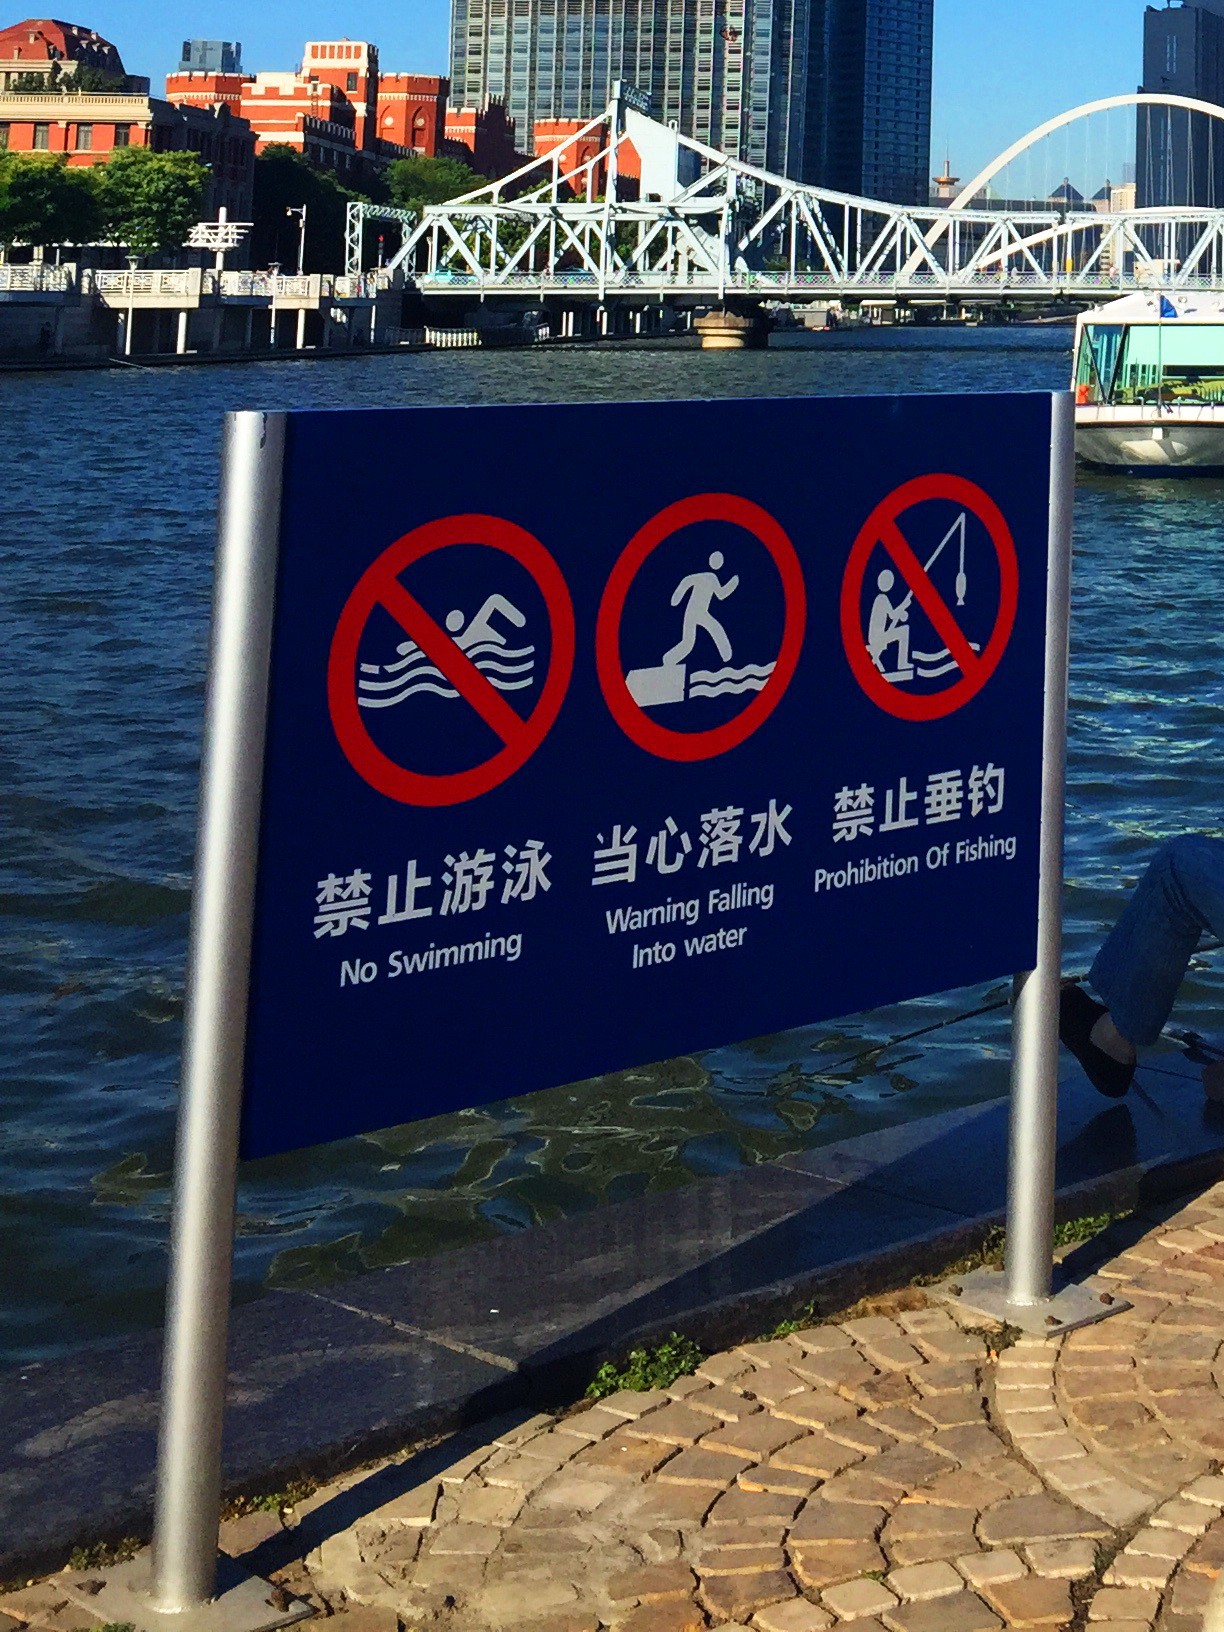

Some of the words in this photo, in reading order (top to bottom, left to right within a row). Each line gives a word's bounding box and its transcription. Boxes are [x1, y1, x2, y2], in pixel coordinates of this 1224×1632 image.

[832, 762, 1005, 843] 禁止垂钓
[591, 798, 793, 886] 当心落水
[814, 853, 919, 893] Prohibition
[925, 842, 950, 870] Of
[955, 834, 1017, 864] Fishing
[313, 839, 553, 939] 禁止游泳
[605, 897, 700, 934] Warning
[708, 882, 774, 914] Falling
[340, 958, 378, 987] No
[388, 932, 522, 978] Swimming
[632, 941, 676, 969] Into
[683, 926, 748, 957] water
